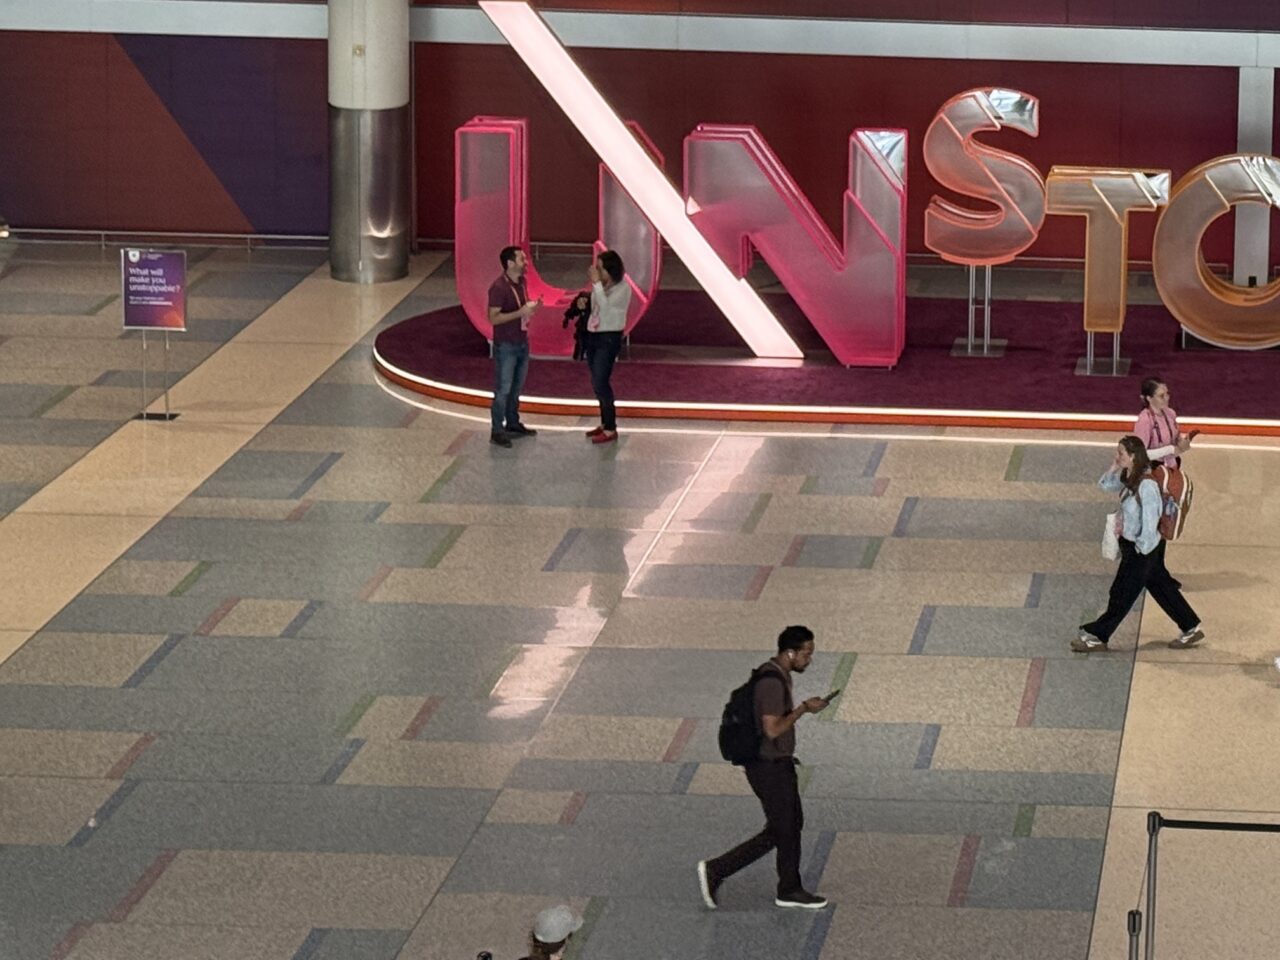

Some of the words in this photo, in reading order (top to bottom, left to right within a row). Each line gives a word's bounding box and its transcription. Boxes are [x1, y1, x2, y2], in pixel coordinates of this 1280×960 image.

[129, 267, 149, 276] What
[150, 268, 163, 276] will
[151, 277, 166, 286] you
